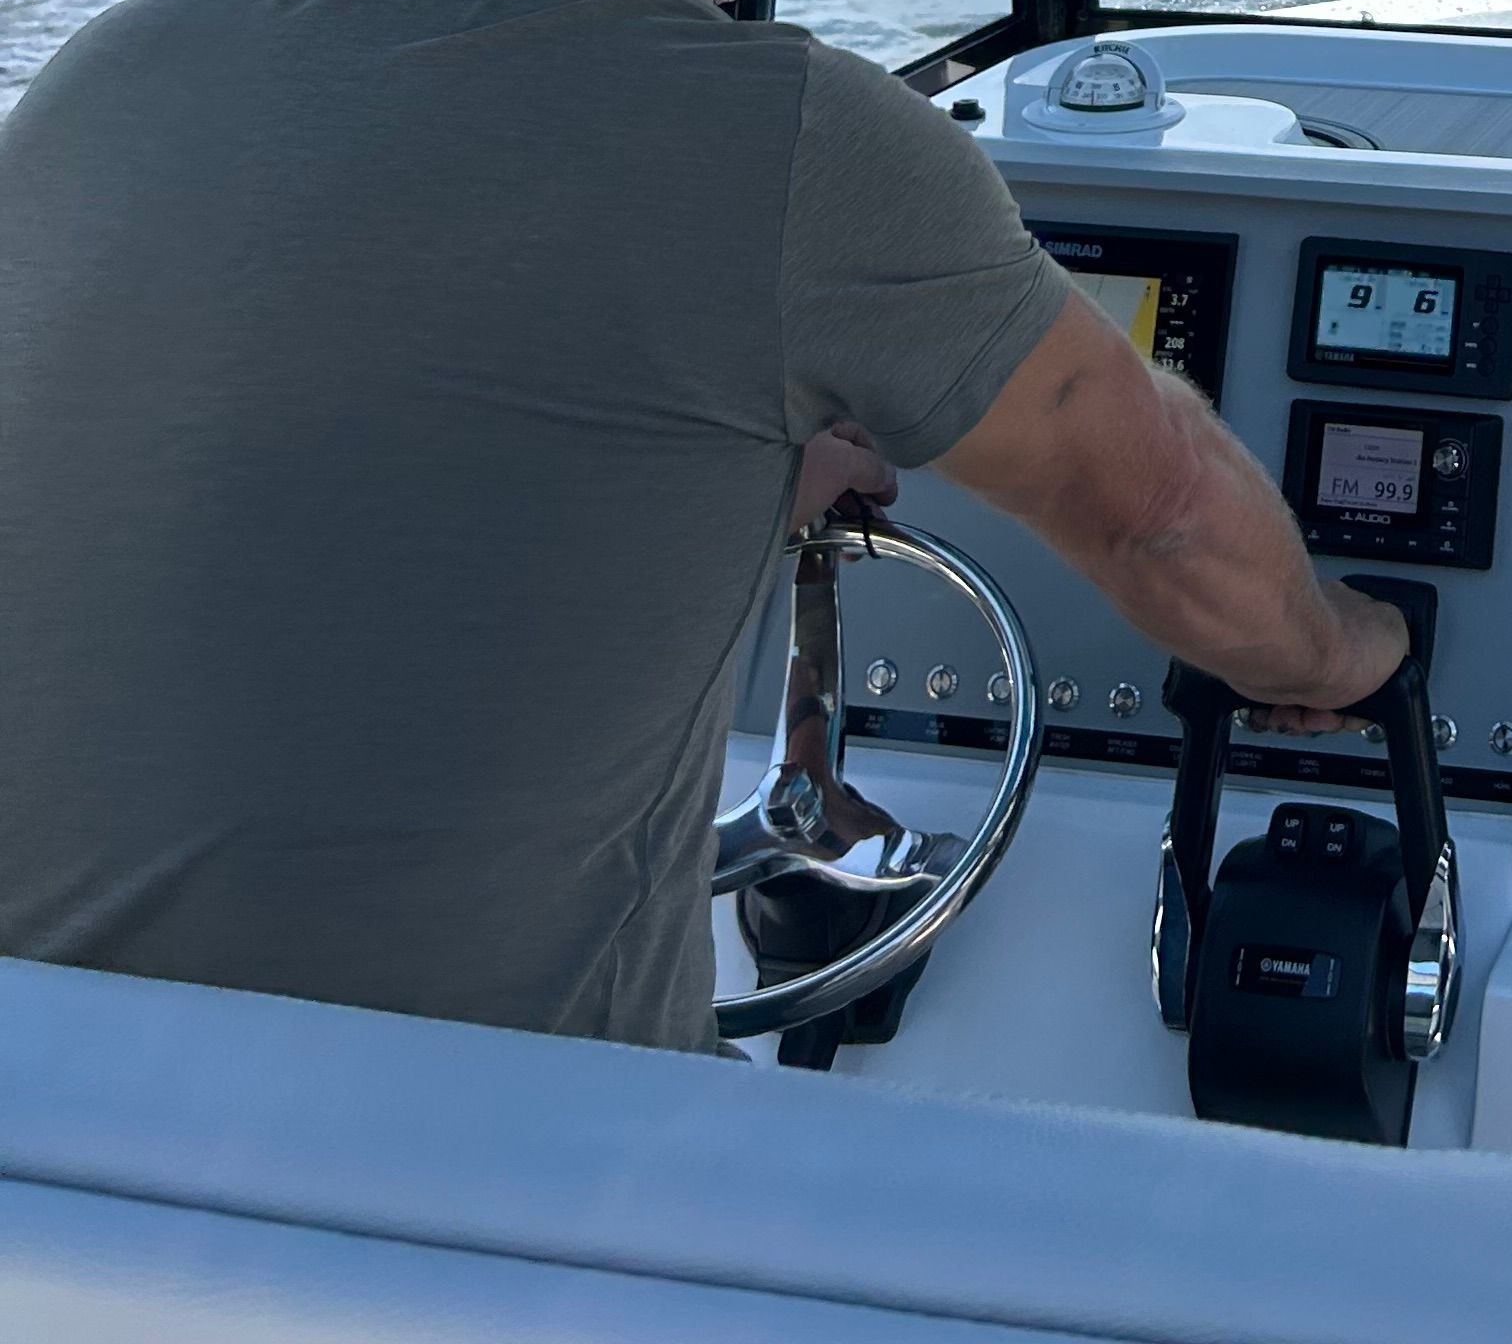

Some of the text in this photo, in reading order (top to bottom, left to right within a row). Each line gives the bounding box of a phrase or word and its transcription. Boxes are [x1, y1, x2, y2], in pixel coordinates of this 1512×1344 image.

[1045, 240, 1103, 259] SIMRAD
[1169, 293, 1189, 307] 3.7
[1347, 284, 1373, 308] 9
[1413, 289, 1439, 314] 6
[1164, 336, 1185, 350] 208
[1332, 477, 1413, 501] FM 99.9
[1339, 511, 1391, 525] JL AUDIO
[1285, 817, 1300, 828] UP
[1329, 823, 1346, 833] UP
[1281, 838, 1297, 848] DN
[1326, 842, 1343, 853] DN
[1272, 959, 1311, 976] YAMAHA
